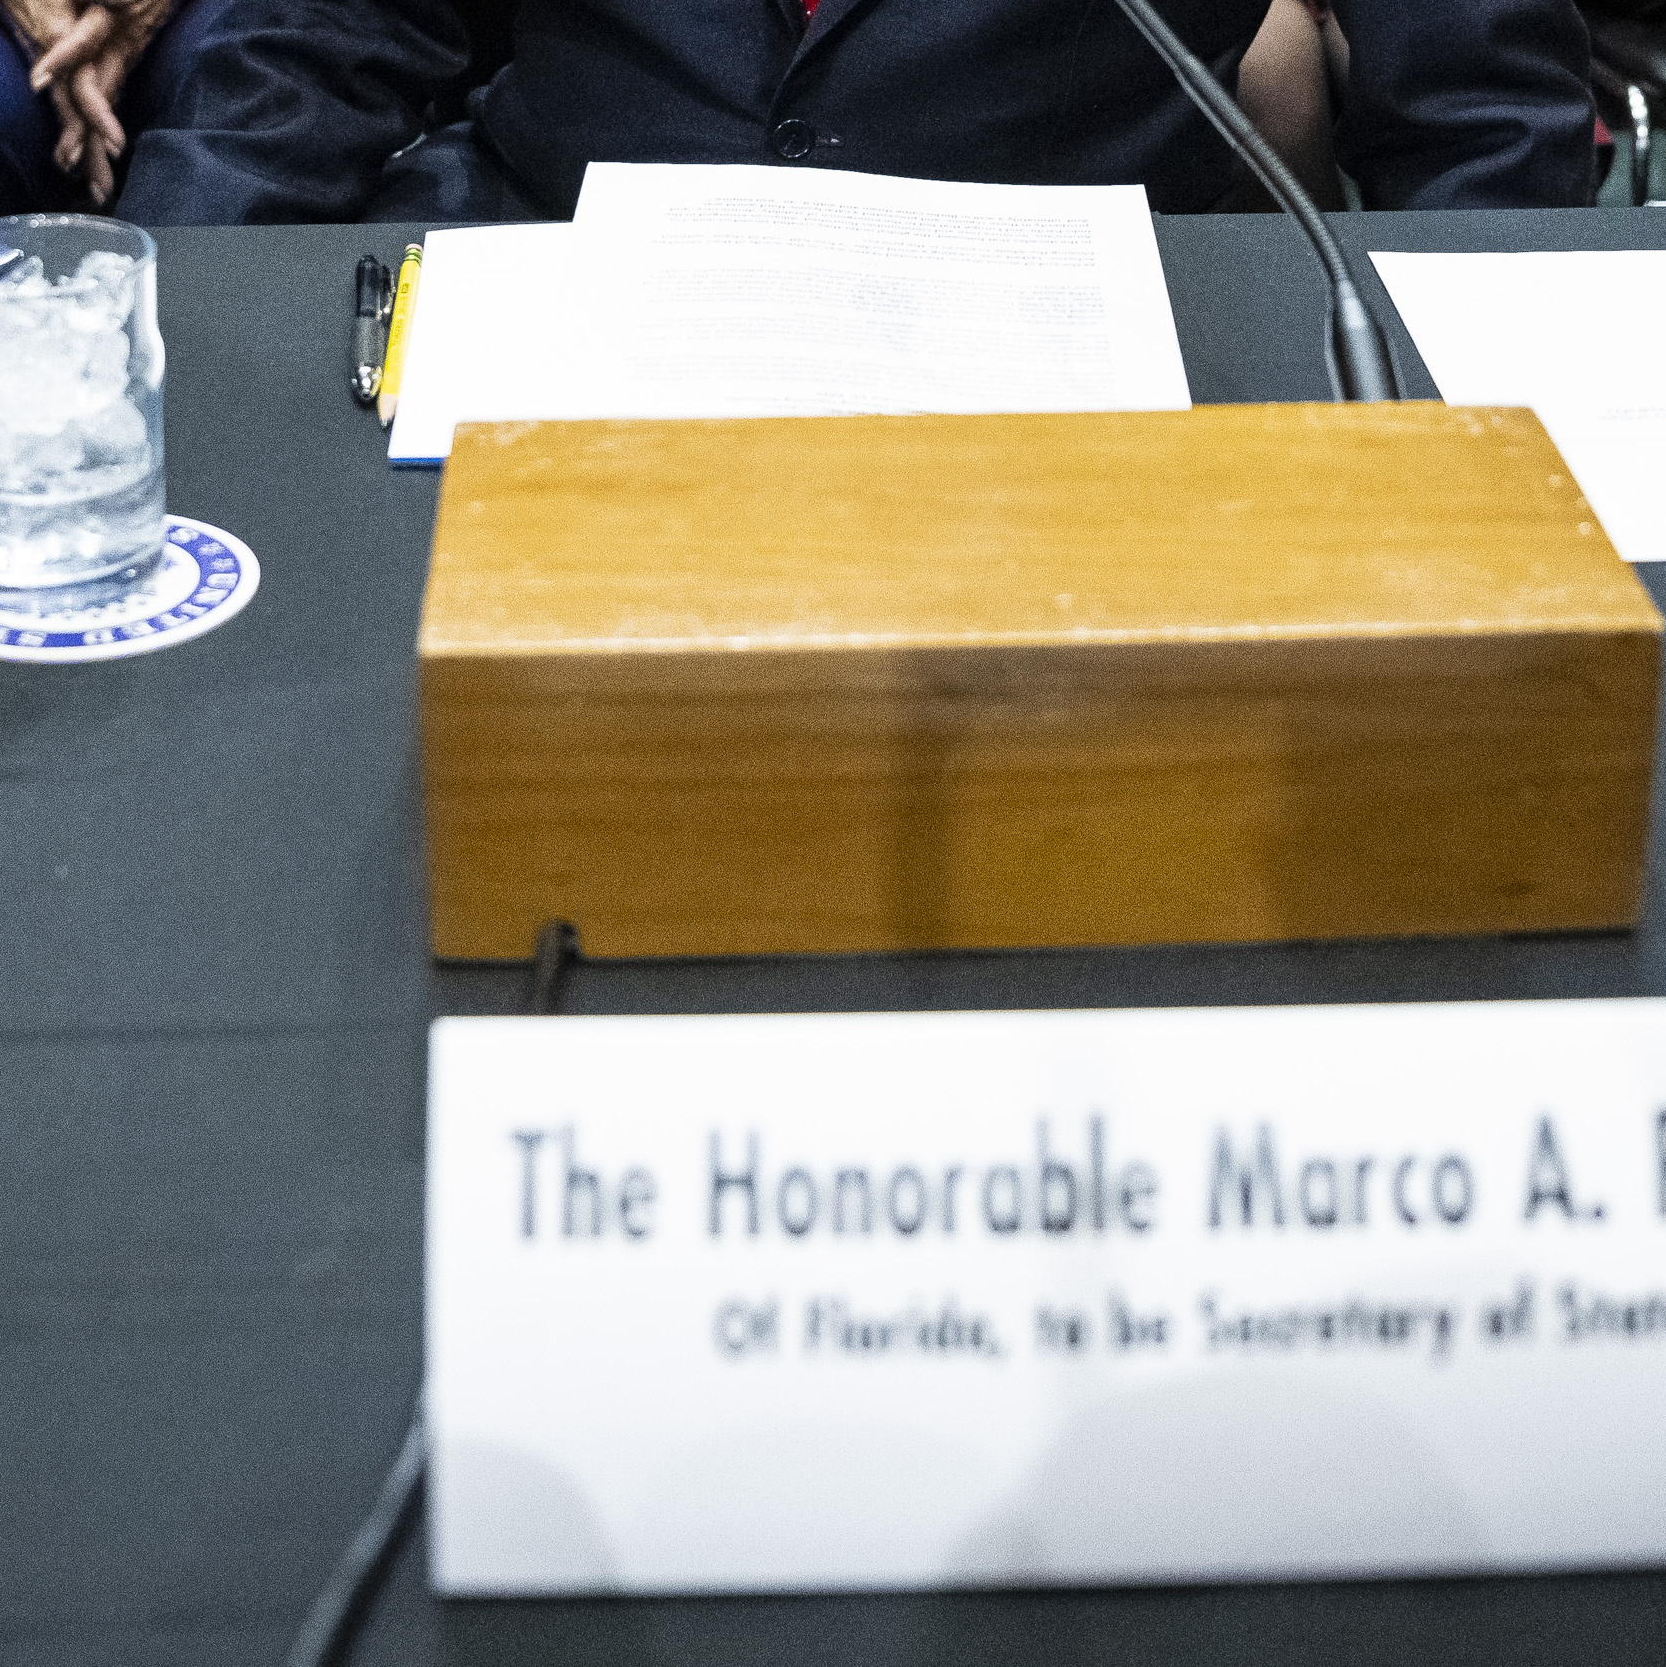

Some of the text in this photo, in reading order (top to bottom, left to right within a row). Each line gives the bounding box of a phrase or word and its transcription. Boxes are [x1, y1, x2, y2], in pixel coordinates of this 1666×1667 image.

[511, 1121, 659, 1240] The
[706, 1107, 1161, 1240] Honorable
[1205, 1117, 1474, 1232] Marco
[1522, 1111, 1607, 1222] A.
[713, 1291, 781, 1361] Of
[803, 1291, 1009, 1361] Florida,
[1035, 1297, 1087, 1357] to
[1106, 1281, 1171, 1352] be
[1197, 1286, 1457, 1368] Secretary
[1485, 1275, 1538, 1345] of
